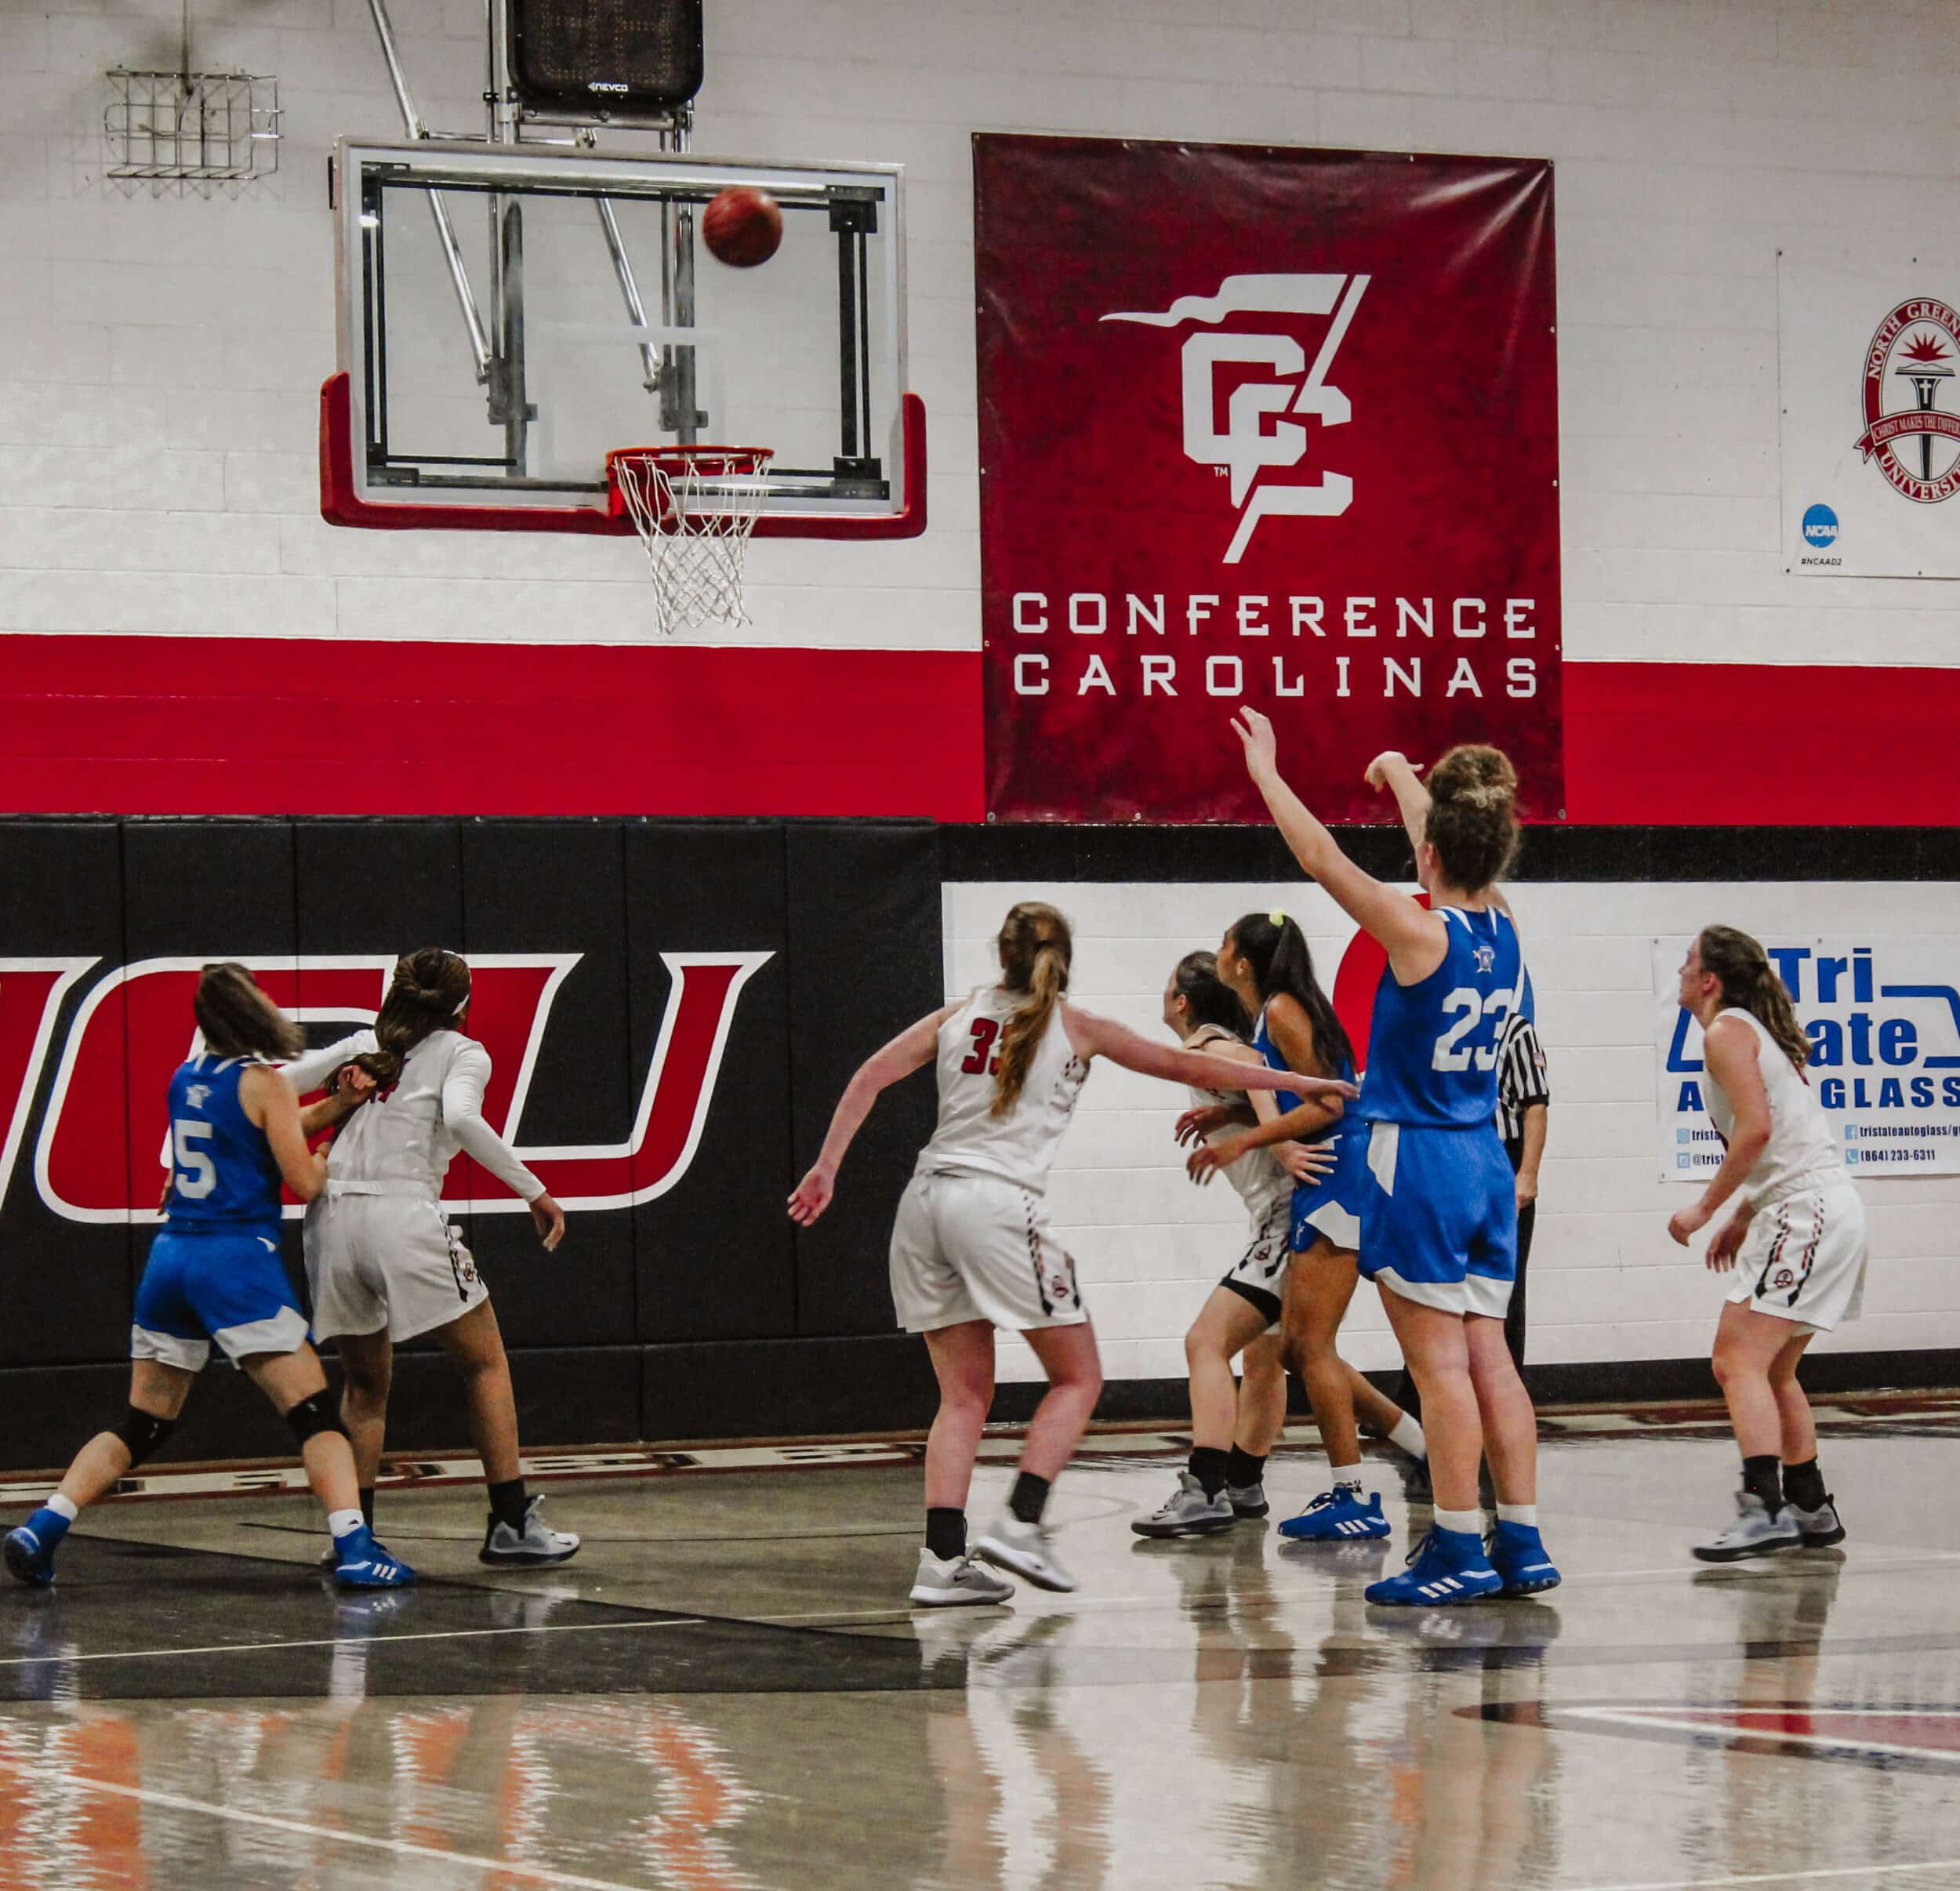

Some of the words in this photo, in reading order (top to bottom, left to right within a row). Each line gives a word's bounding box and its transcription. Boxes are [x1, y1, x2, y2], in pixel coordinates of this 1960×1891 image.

[1868, 317, 1902, 379] NORTH
[1907, 302, 1960, 343] GREEN
[1806, 524, 1838, 537] NCAA
[1012, 592, 1537, 639] CONFERENCE
[1014, 653, 1537, 699] CAROLINAS
[1768, 947, 1874, 1004] Tri
[1431, 987, 1515, 1072] 23
[1820, 1076, 1960, 1109] GLASS
[174, 1119, 216, 1199] 5
[1860, 1150, 1889, 1162] (864)
[1890, 1149, 1936, 1161] 233-6311
